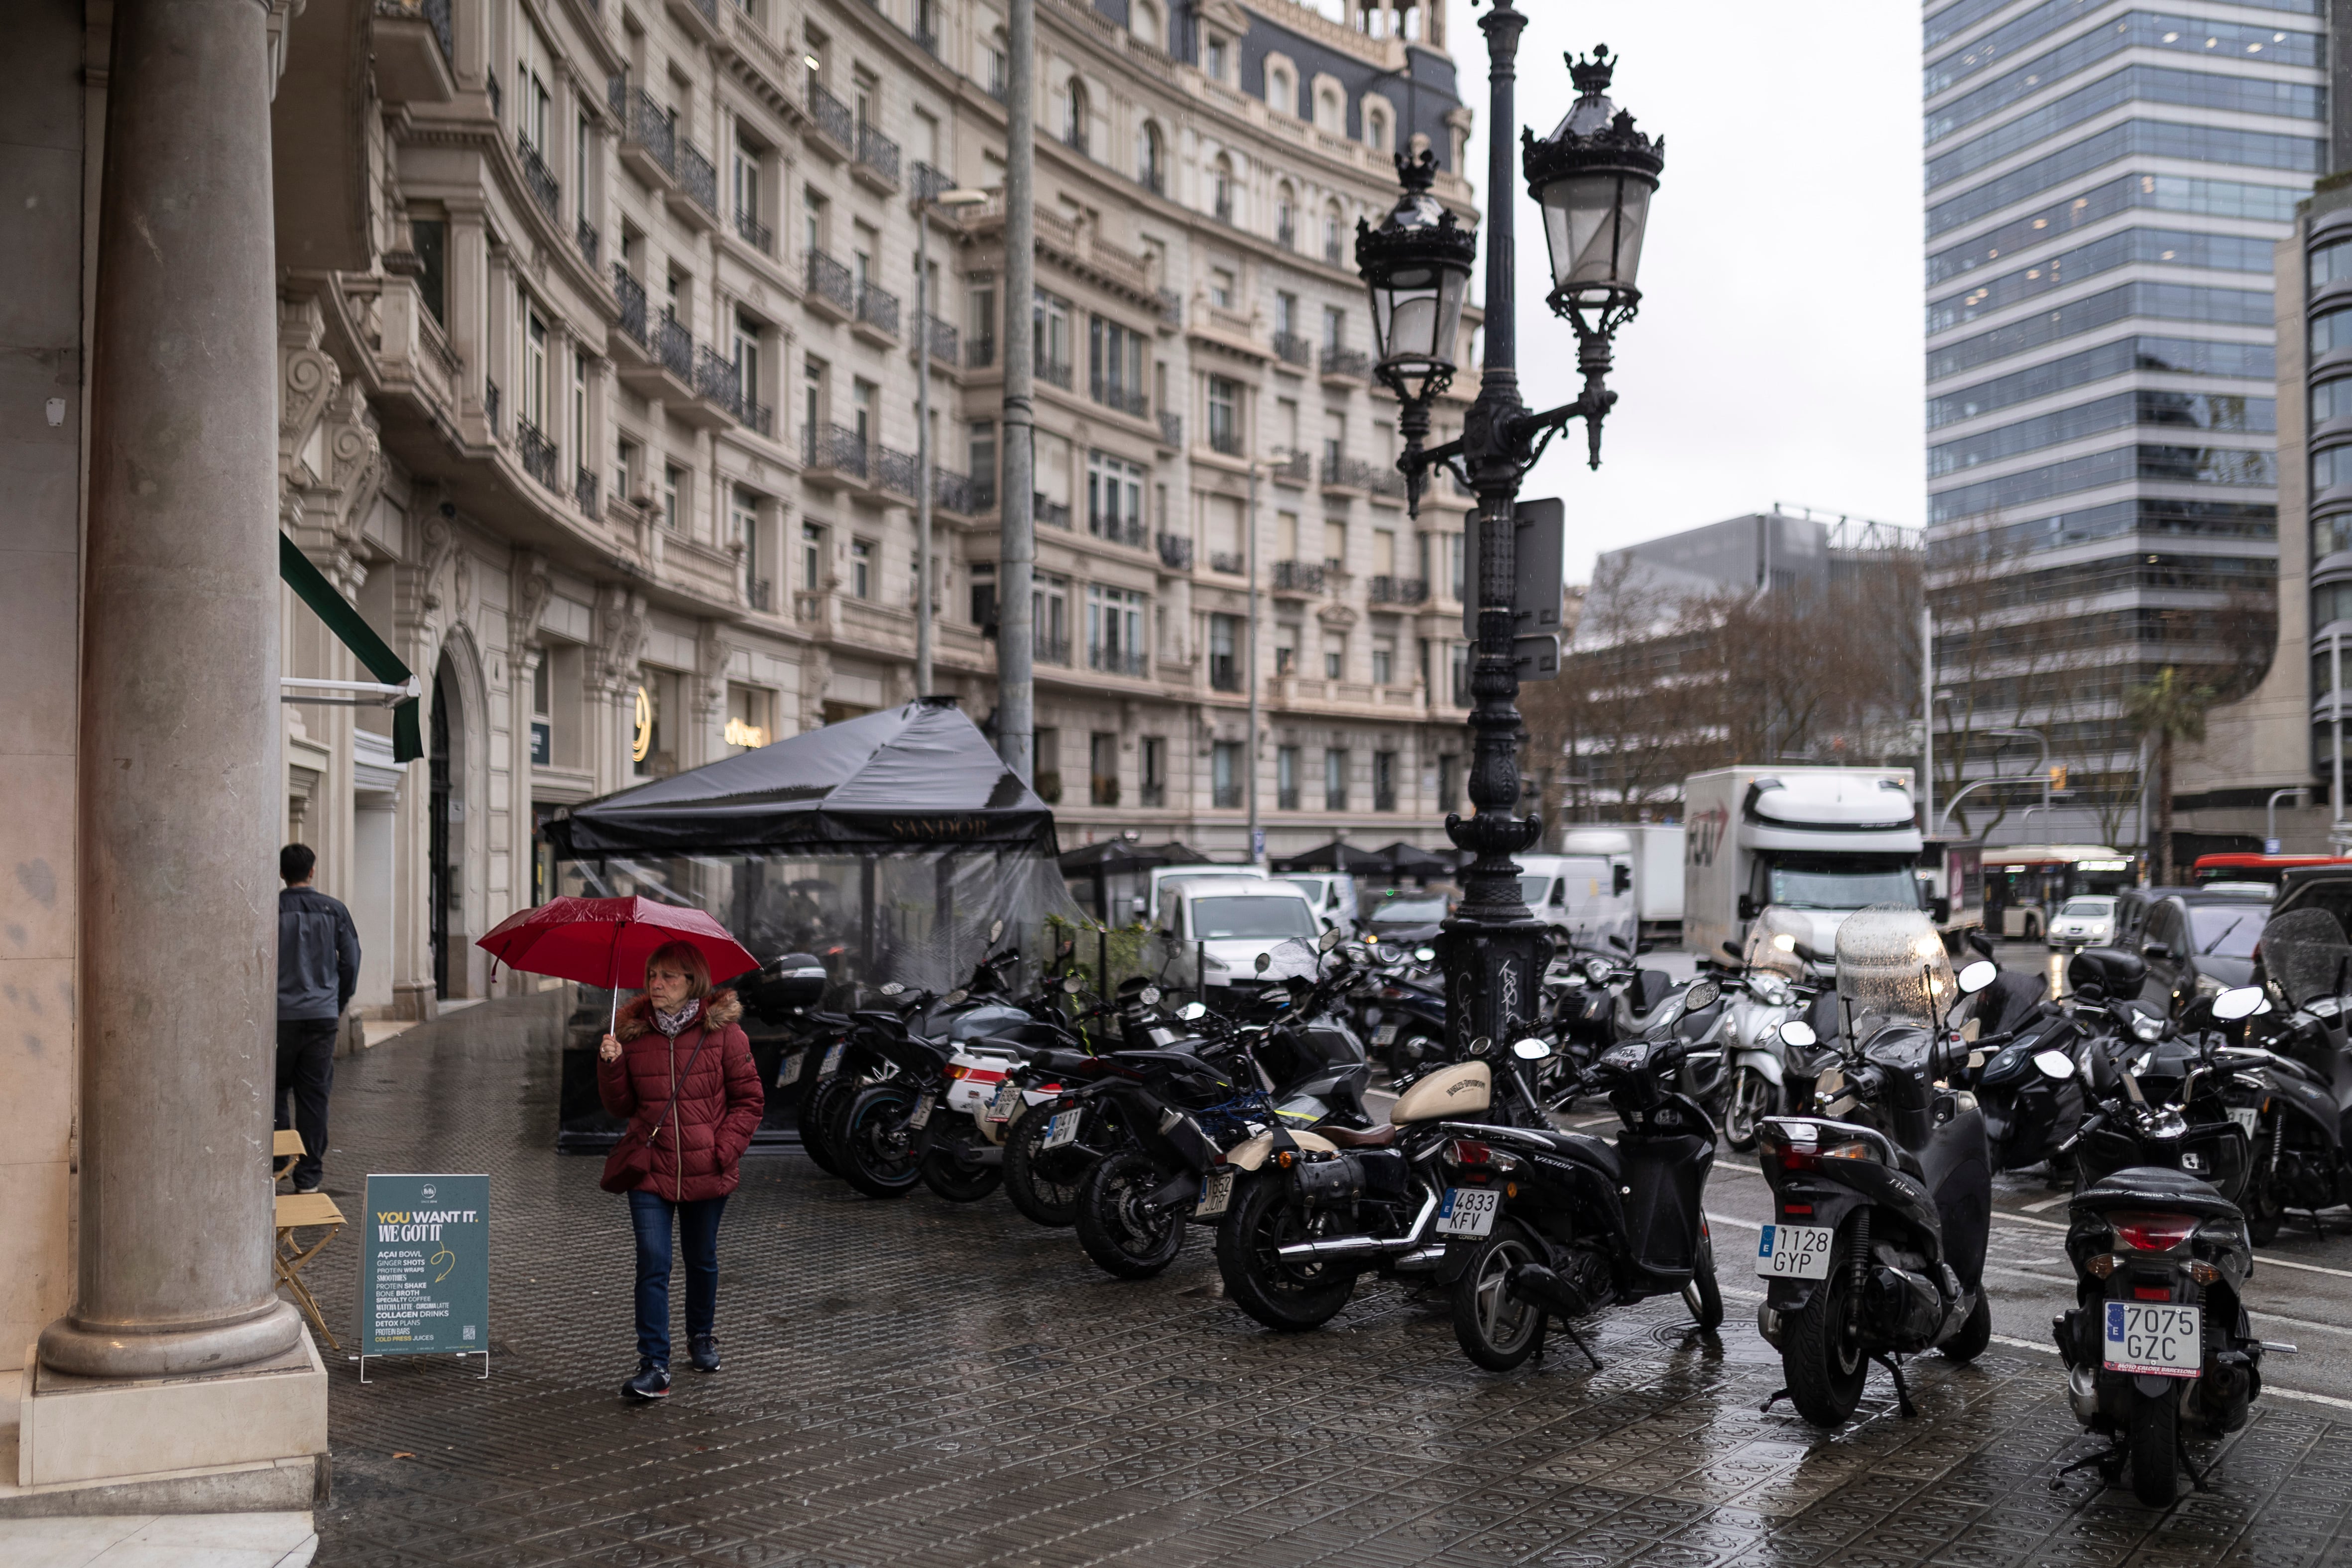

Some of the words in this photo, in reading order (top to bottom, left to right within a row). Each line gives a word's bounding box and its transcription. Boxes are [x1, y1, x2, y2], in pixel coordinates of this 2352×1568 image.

[892, 821, 987, 837] SANDOR
[1534, 1155, 1574, 1170] VISION
[1208, 1176, 1231, 1195] 1652
[1205, 1194, 1226, 1211] JDR
[1455, 1193, 1494, 1211] 4833
[377, 1211, 410, 1224] YOU
[412, 1211, 461, 1223] WANT
[463, 1210, 478, 1223] IT.
[1449, 1211, 1481, 1230] KFV
[378, 1224, 399, 1242] WE
[401, 1224, 429, 1242] GOT
[430, 1224, 443, 1241] IT
[1781, 1229, 1828, 1252] 1128
[1774, 1252, 1811, 1273] GYP
[2127, 1308, 2193, 1335] 7075
[2127, 1334, 2176, 1361] GZC
